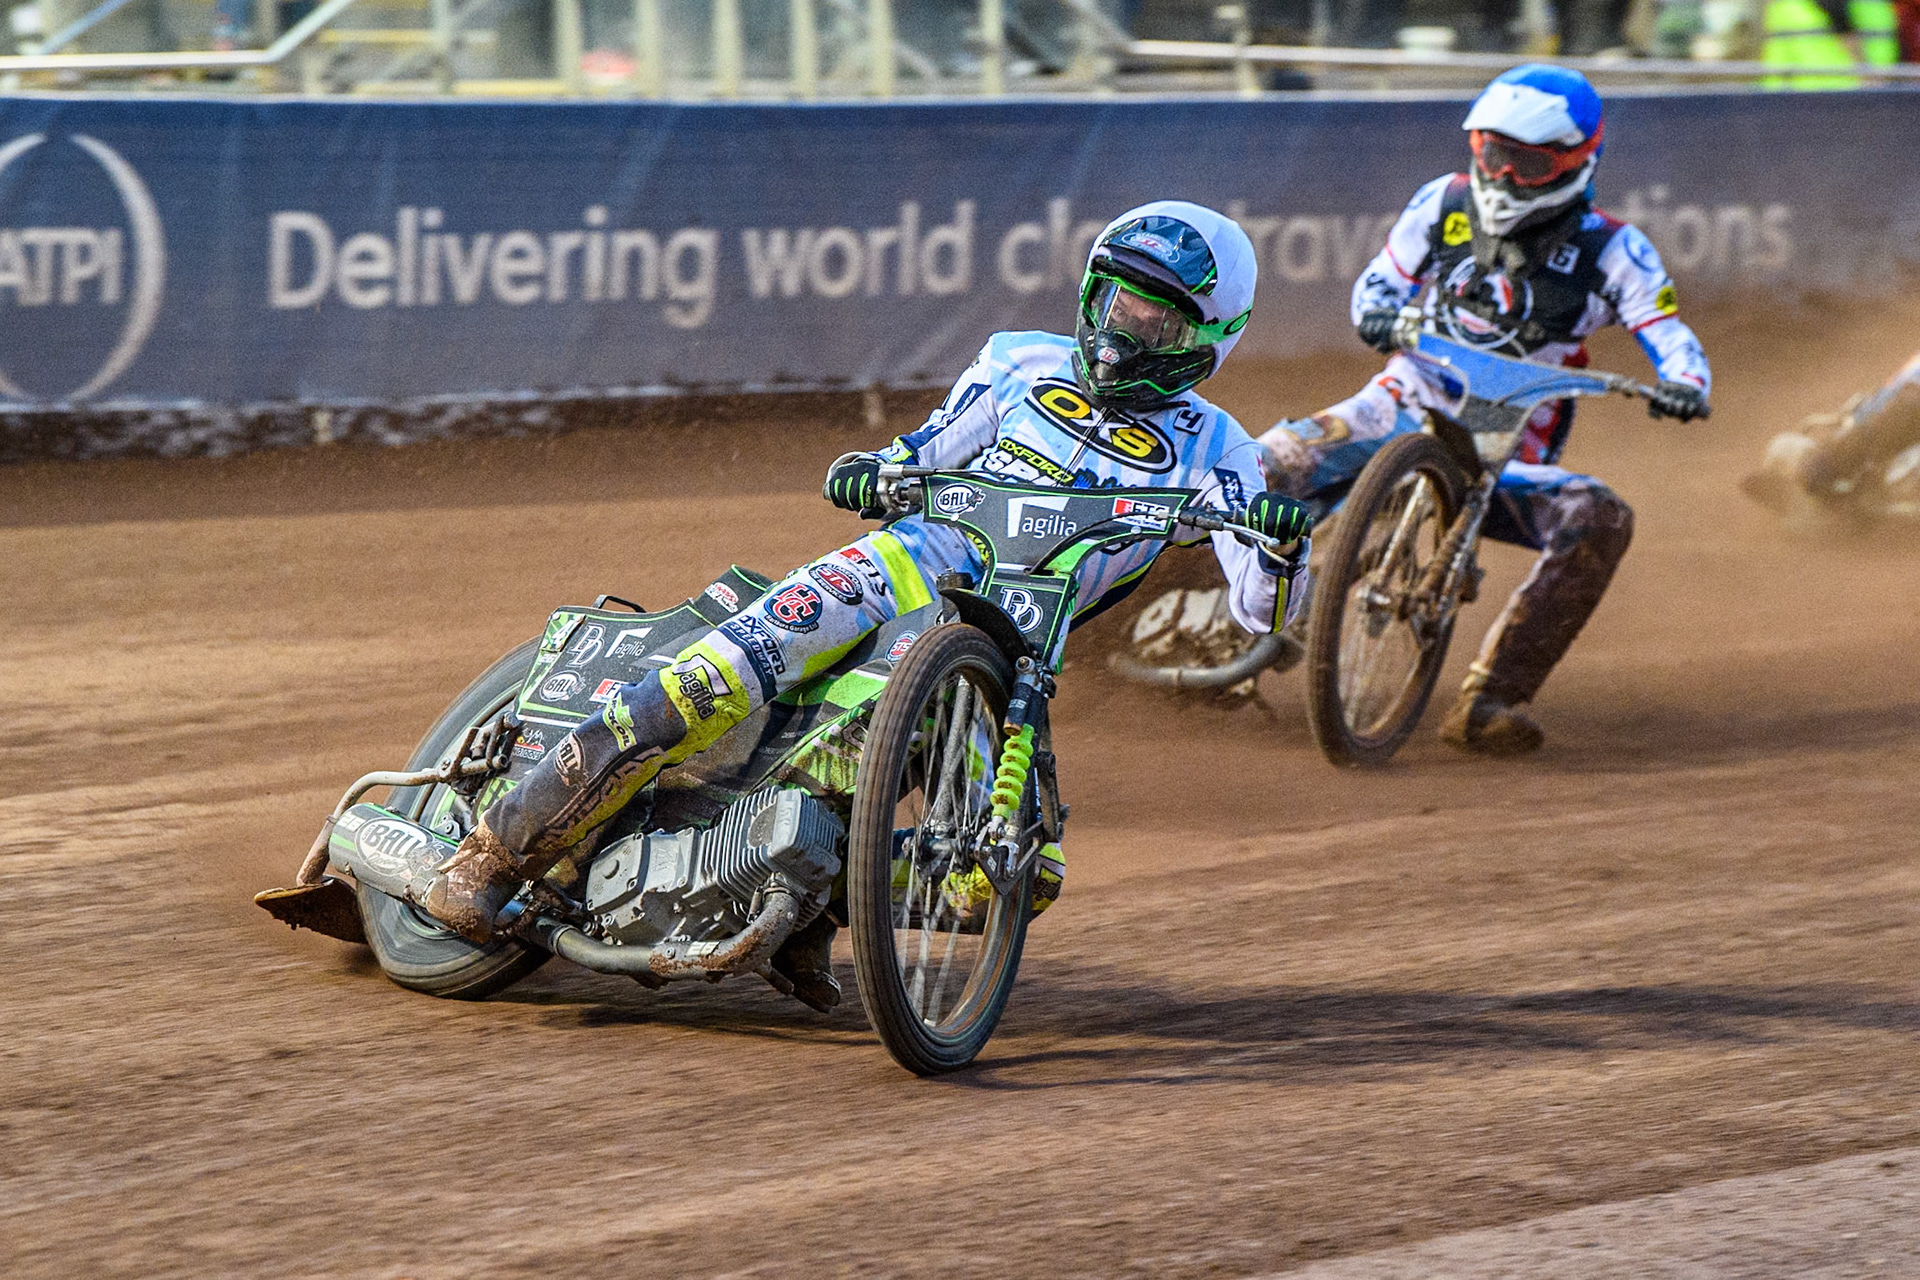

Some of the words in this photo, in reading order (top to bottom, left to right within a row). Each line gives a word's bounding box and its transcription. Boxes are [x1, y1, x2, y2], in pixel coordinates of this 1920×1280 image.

[268, 207, 718, 328] Delivering
[742, 199, 978, 300] world
[1039, 387, 1159, 458] OXS
[1183, 410, 1202, 430] 4
[1000, 438, 1075, 484] OXFORD
[1021, 514, 1078, 539] agilia
[818, 566, 853, 594] STS
[856, 558, 888, 597] FTS
[613, 640, 646, 659] agilia
[729, 623, 773, 675] SPEEDWAY
[738, 614, 787, 676] OXFORD
[678, 670, 717, 721] agilia
